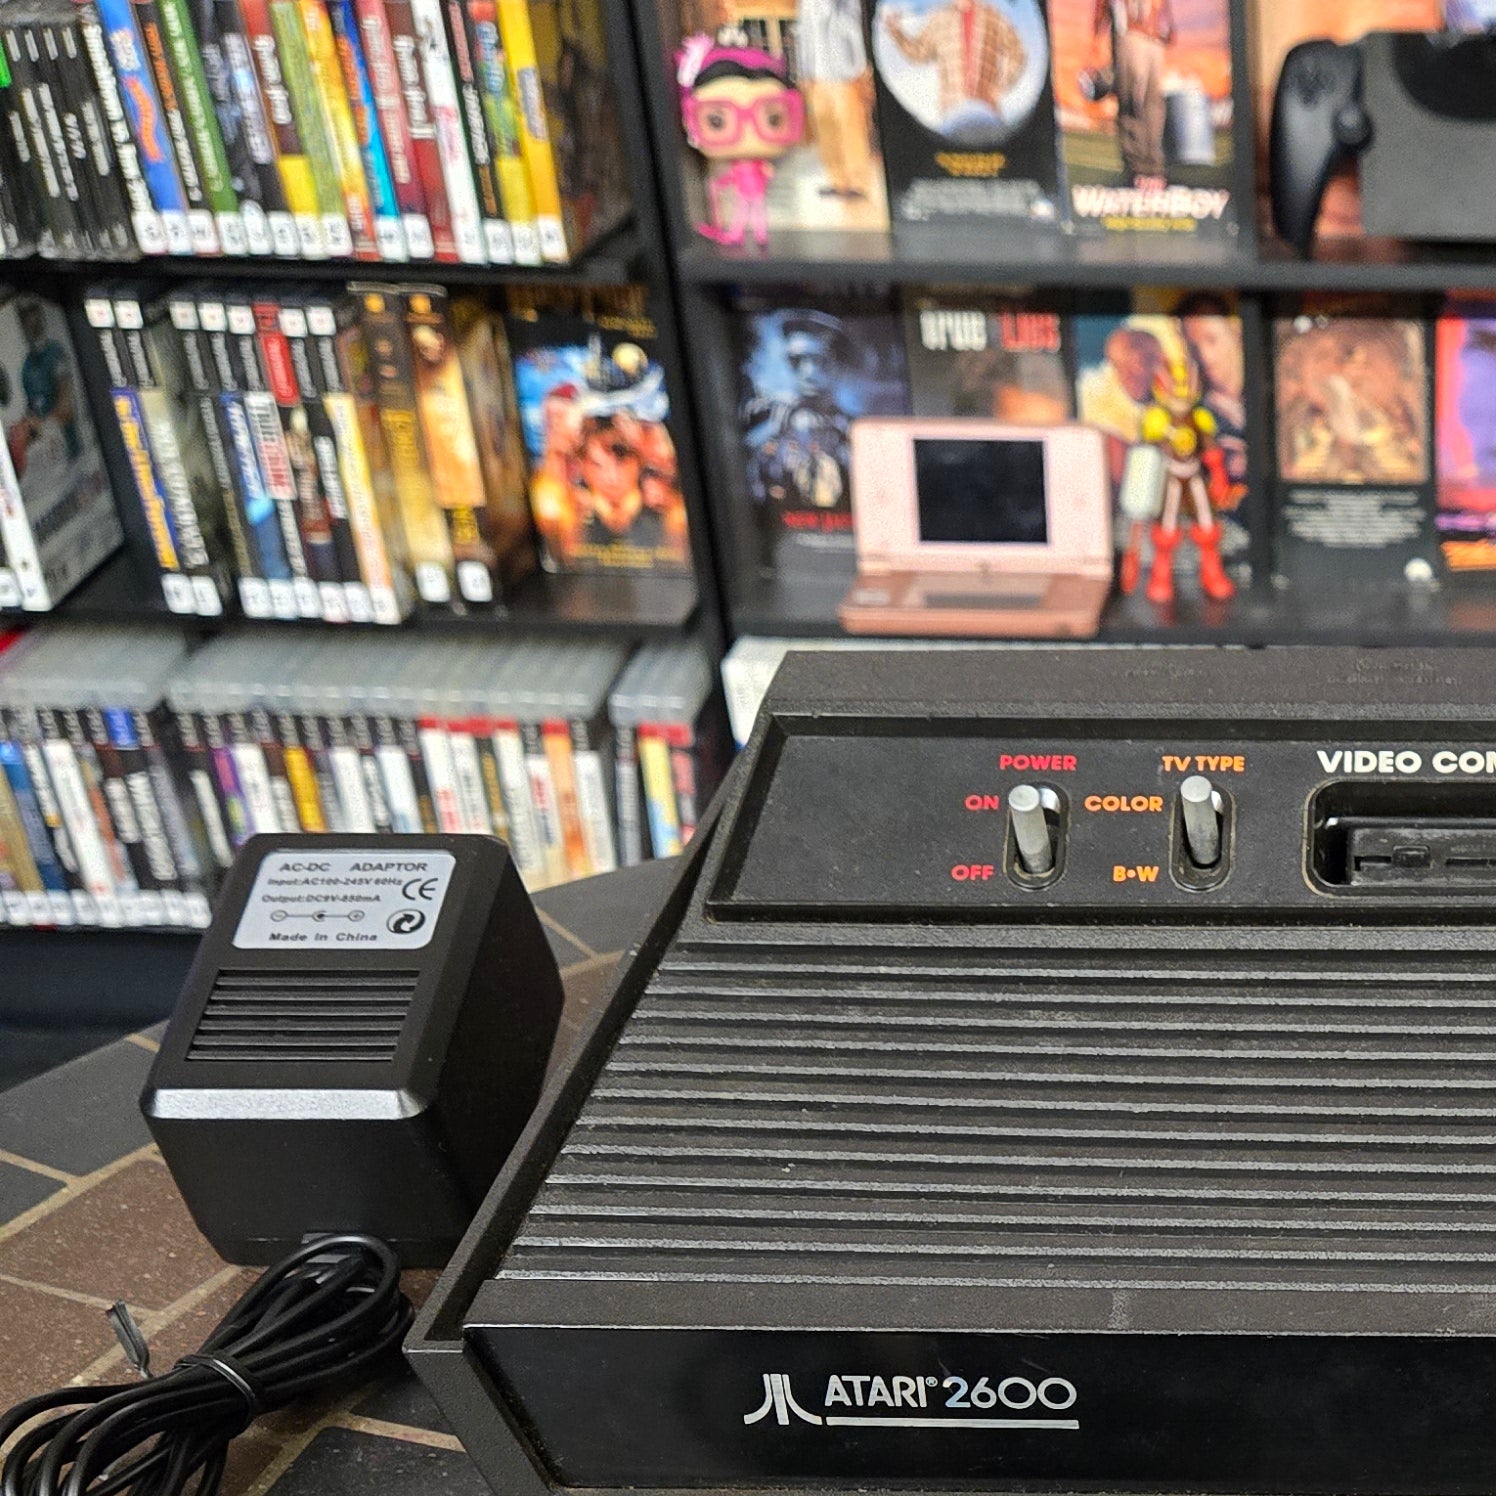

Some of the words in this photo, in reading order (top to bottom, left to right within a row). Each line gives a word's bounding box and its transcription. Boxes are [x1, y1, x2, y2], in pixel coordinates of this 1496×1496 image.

[1000, 755, 1077, 771] POWER
[1163, 756, 1190, 771] TV
[1196, 756, 1245, 772] TYPE
[1317, 750, 1422, 774] VIDEO
[965, 795, 999, 810] ON
[1085, 796, 1163, 812] COLOR
[279, 862, 331, 872] AC-DC
[349, 862, 428, 872] ADAPTOR
[952, 865, 994, 881] OFF
[269, 932, 308, 942] Made
[314, 932, 328, 942] in
[336, 931, 378, 942] China
[942, 1376, 1077, 1410] 2600
